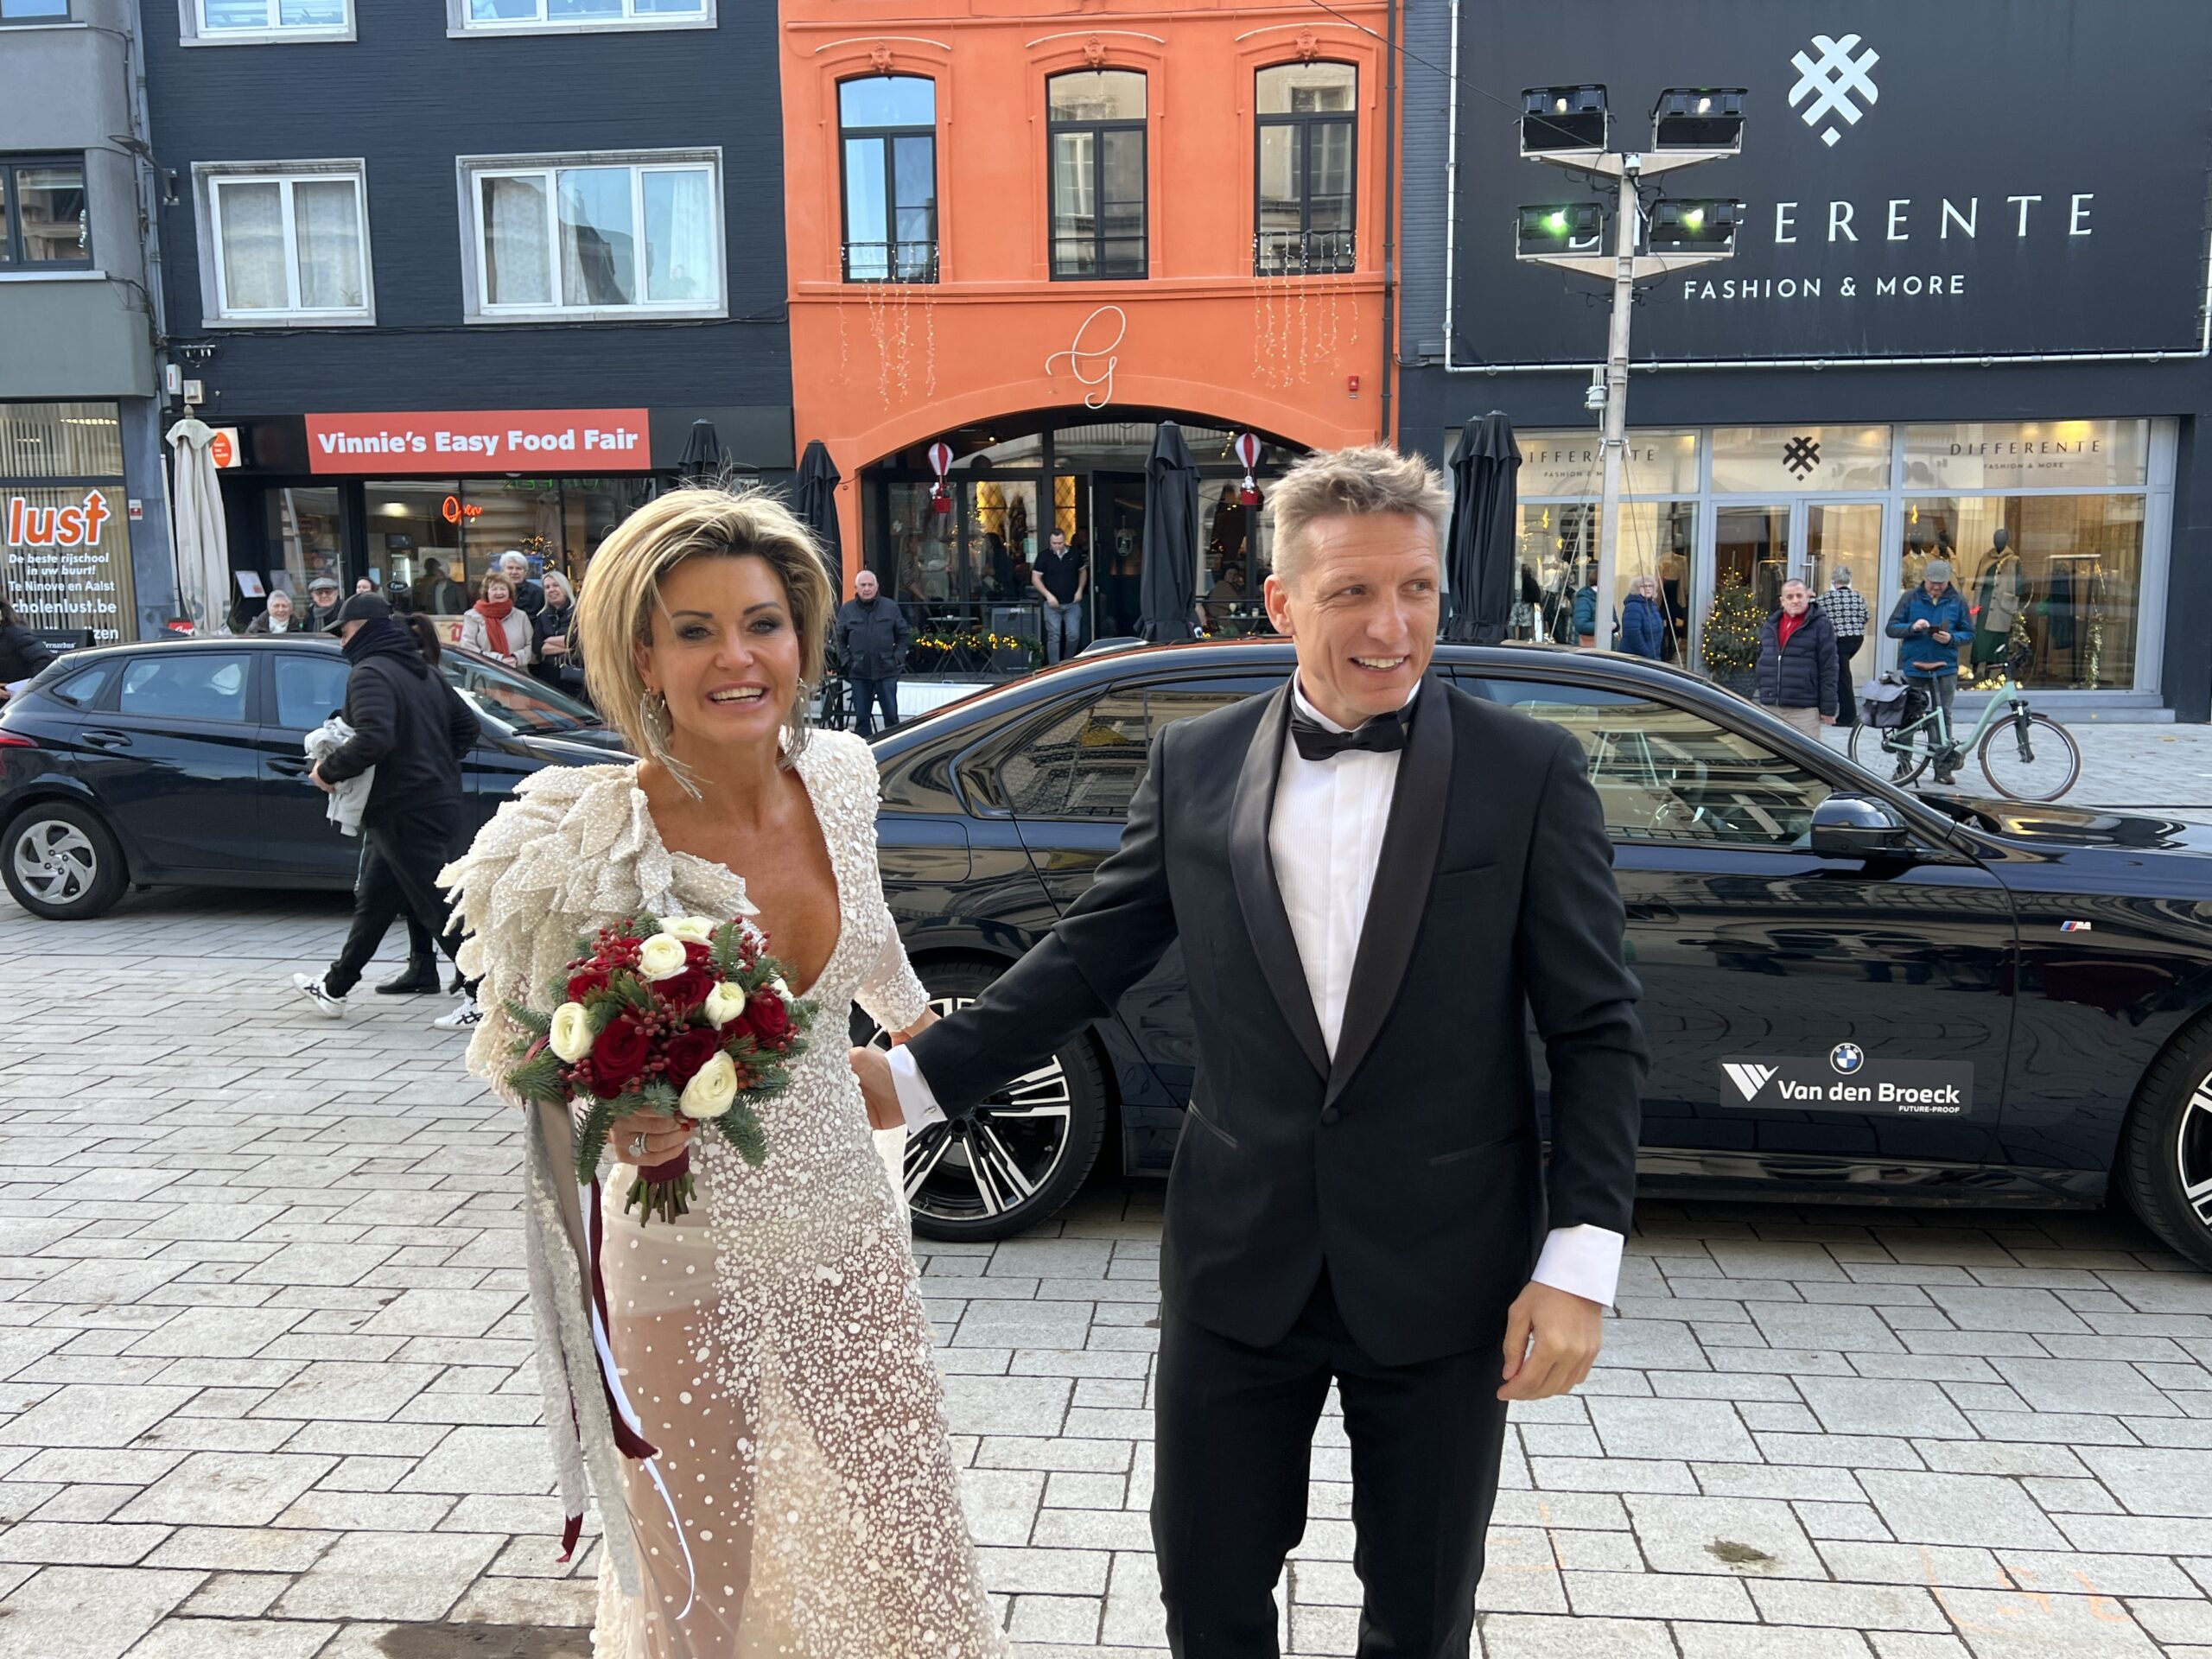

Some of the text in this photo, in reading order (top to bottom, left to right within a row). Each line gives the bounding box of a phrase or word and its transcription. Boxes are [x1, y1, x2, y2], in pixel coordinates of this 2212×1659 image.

[1568, 194, 2094, 248] IERENTE
[1684, 275, 1965, 300] FASHION & MORE
[317, 428, 639, 456] Vinnie's Easy Food Fair
[1950, 441, 2101, 455] DIFFERENTE
[1529, 449, 1655, 463] IFFERTE
[9, 489, 111, 546] lust
[9, 553, 109, 565] De beste rijschool
[27, 565, 96, 575] in uw buurt!
[8, 581, 115, 591] Te Ninove en Aalst
[12, 598, 117, 613] cholenlust.be
[1777, 1080, 1960, 1104] Van den Broeck
[1898, 1105, 1960, 1114] FUTURE-PROOF
